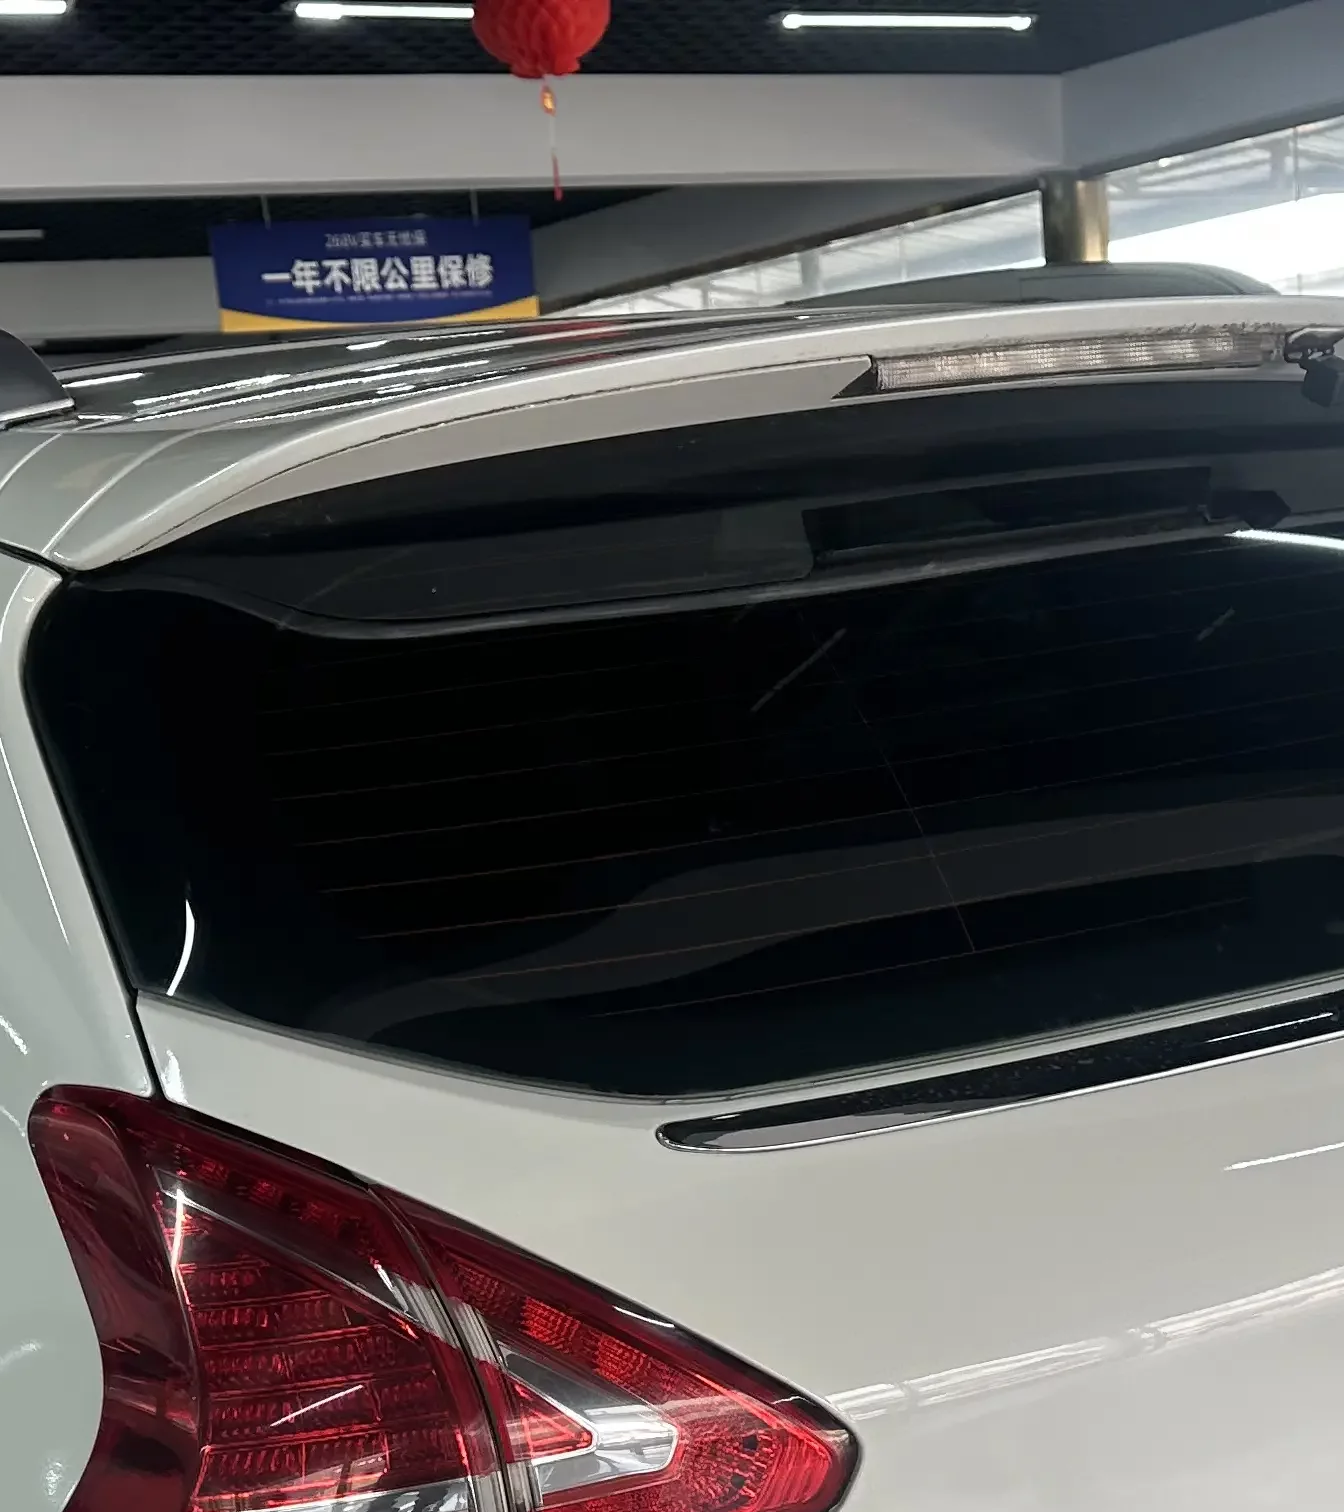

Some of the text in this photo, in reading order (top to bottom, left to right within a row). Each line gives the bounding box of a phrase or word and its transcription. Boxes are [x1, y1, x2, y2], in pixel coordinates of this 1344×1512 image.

[262, 253, 494, 296] 一年不限公里保修
